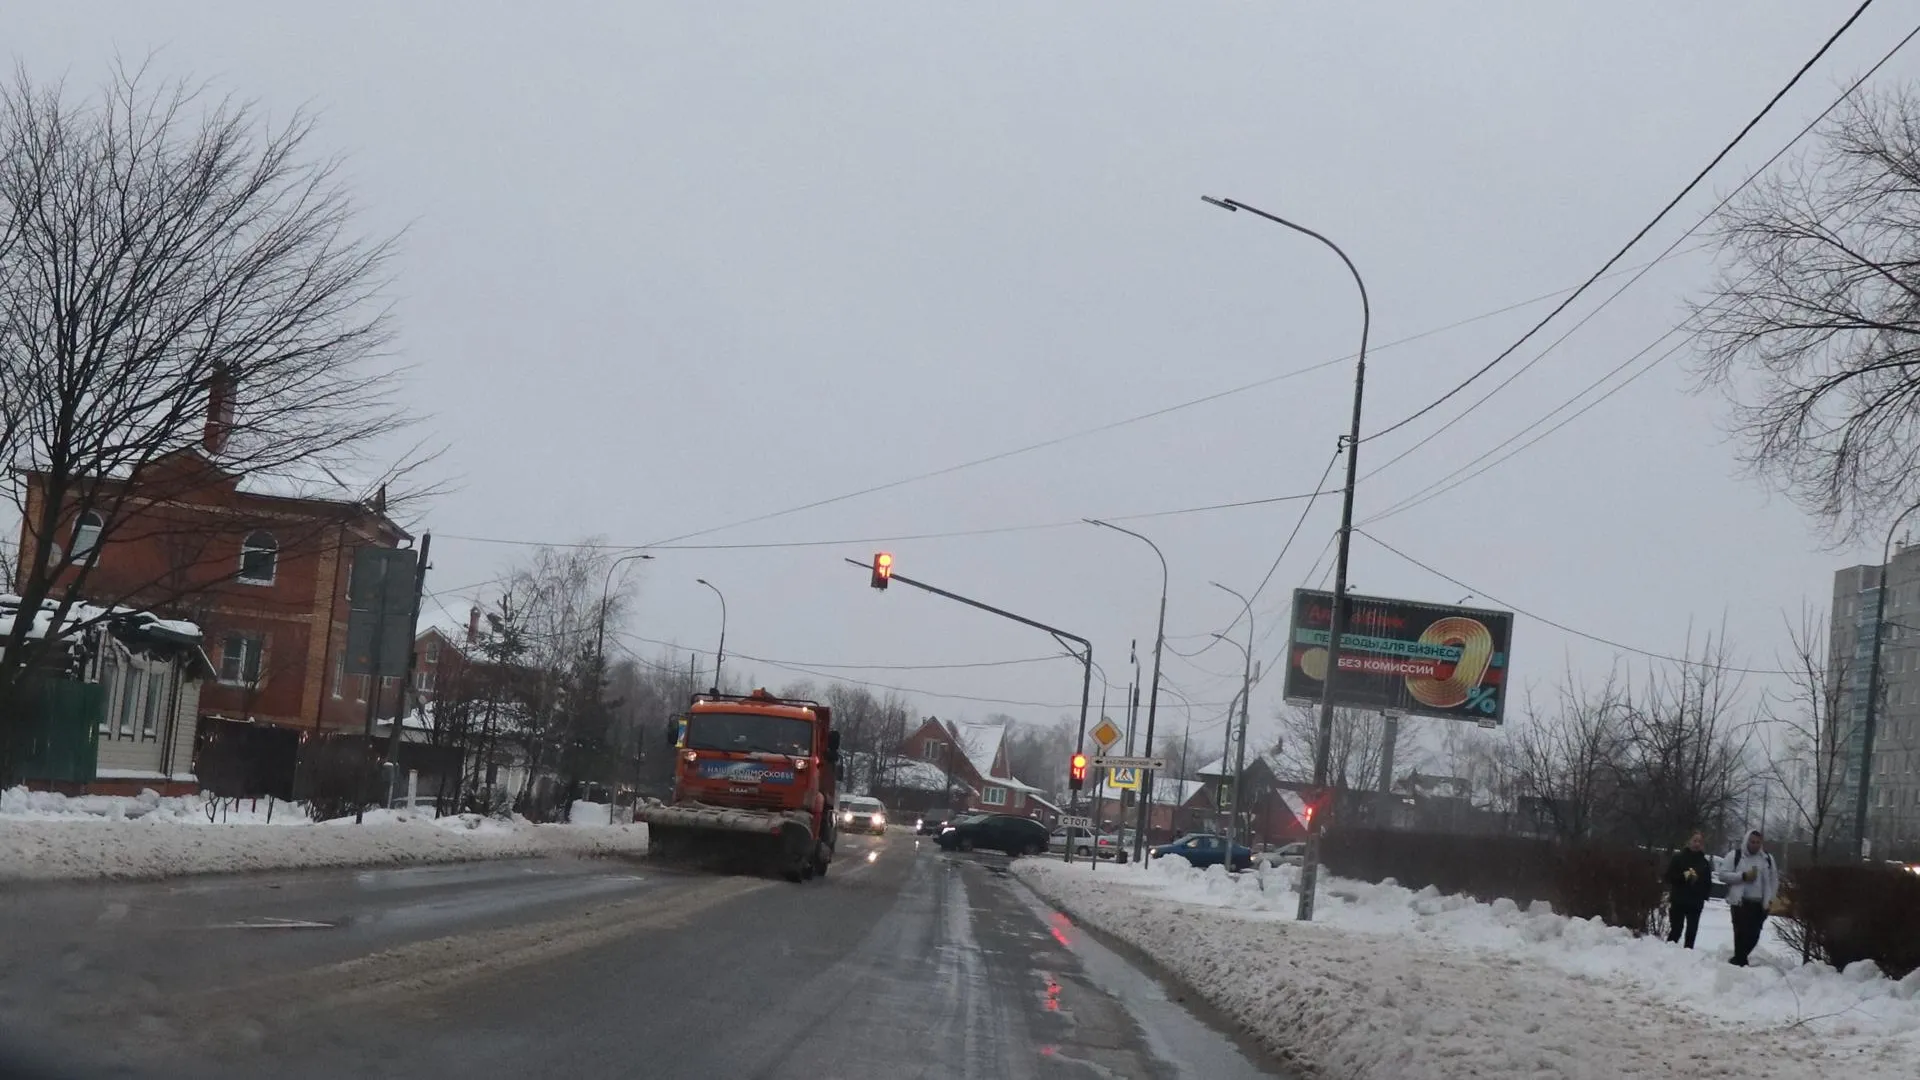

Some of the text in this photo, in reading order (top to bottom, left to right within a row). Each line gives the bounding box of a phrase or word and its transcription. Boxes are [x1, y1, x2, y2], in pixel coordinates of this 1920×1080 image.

[1314, 632, 1461, 658] ПЕЕВОДЫ ДЛЯ БИЗНЕСА
[1337, 658, 1434, 675] БЕЗ КОМИССИИ
[1073, 767, 1085, 779] 41
[1062, 816, 1088, 827] СТОП
